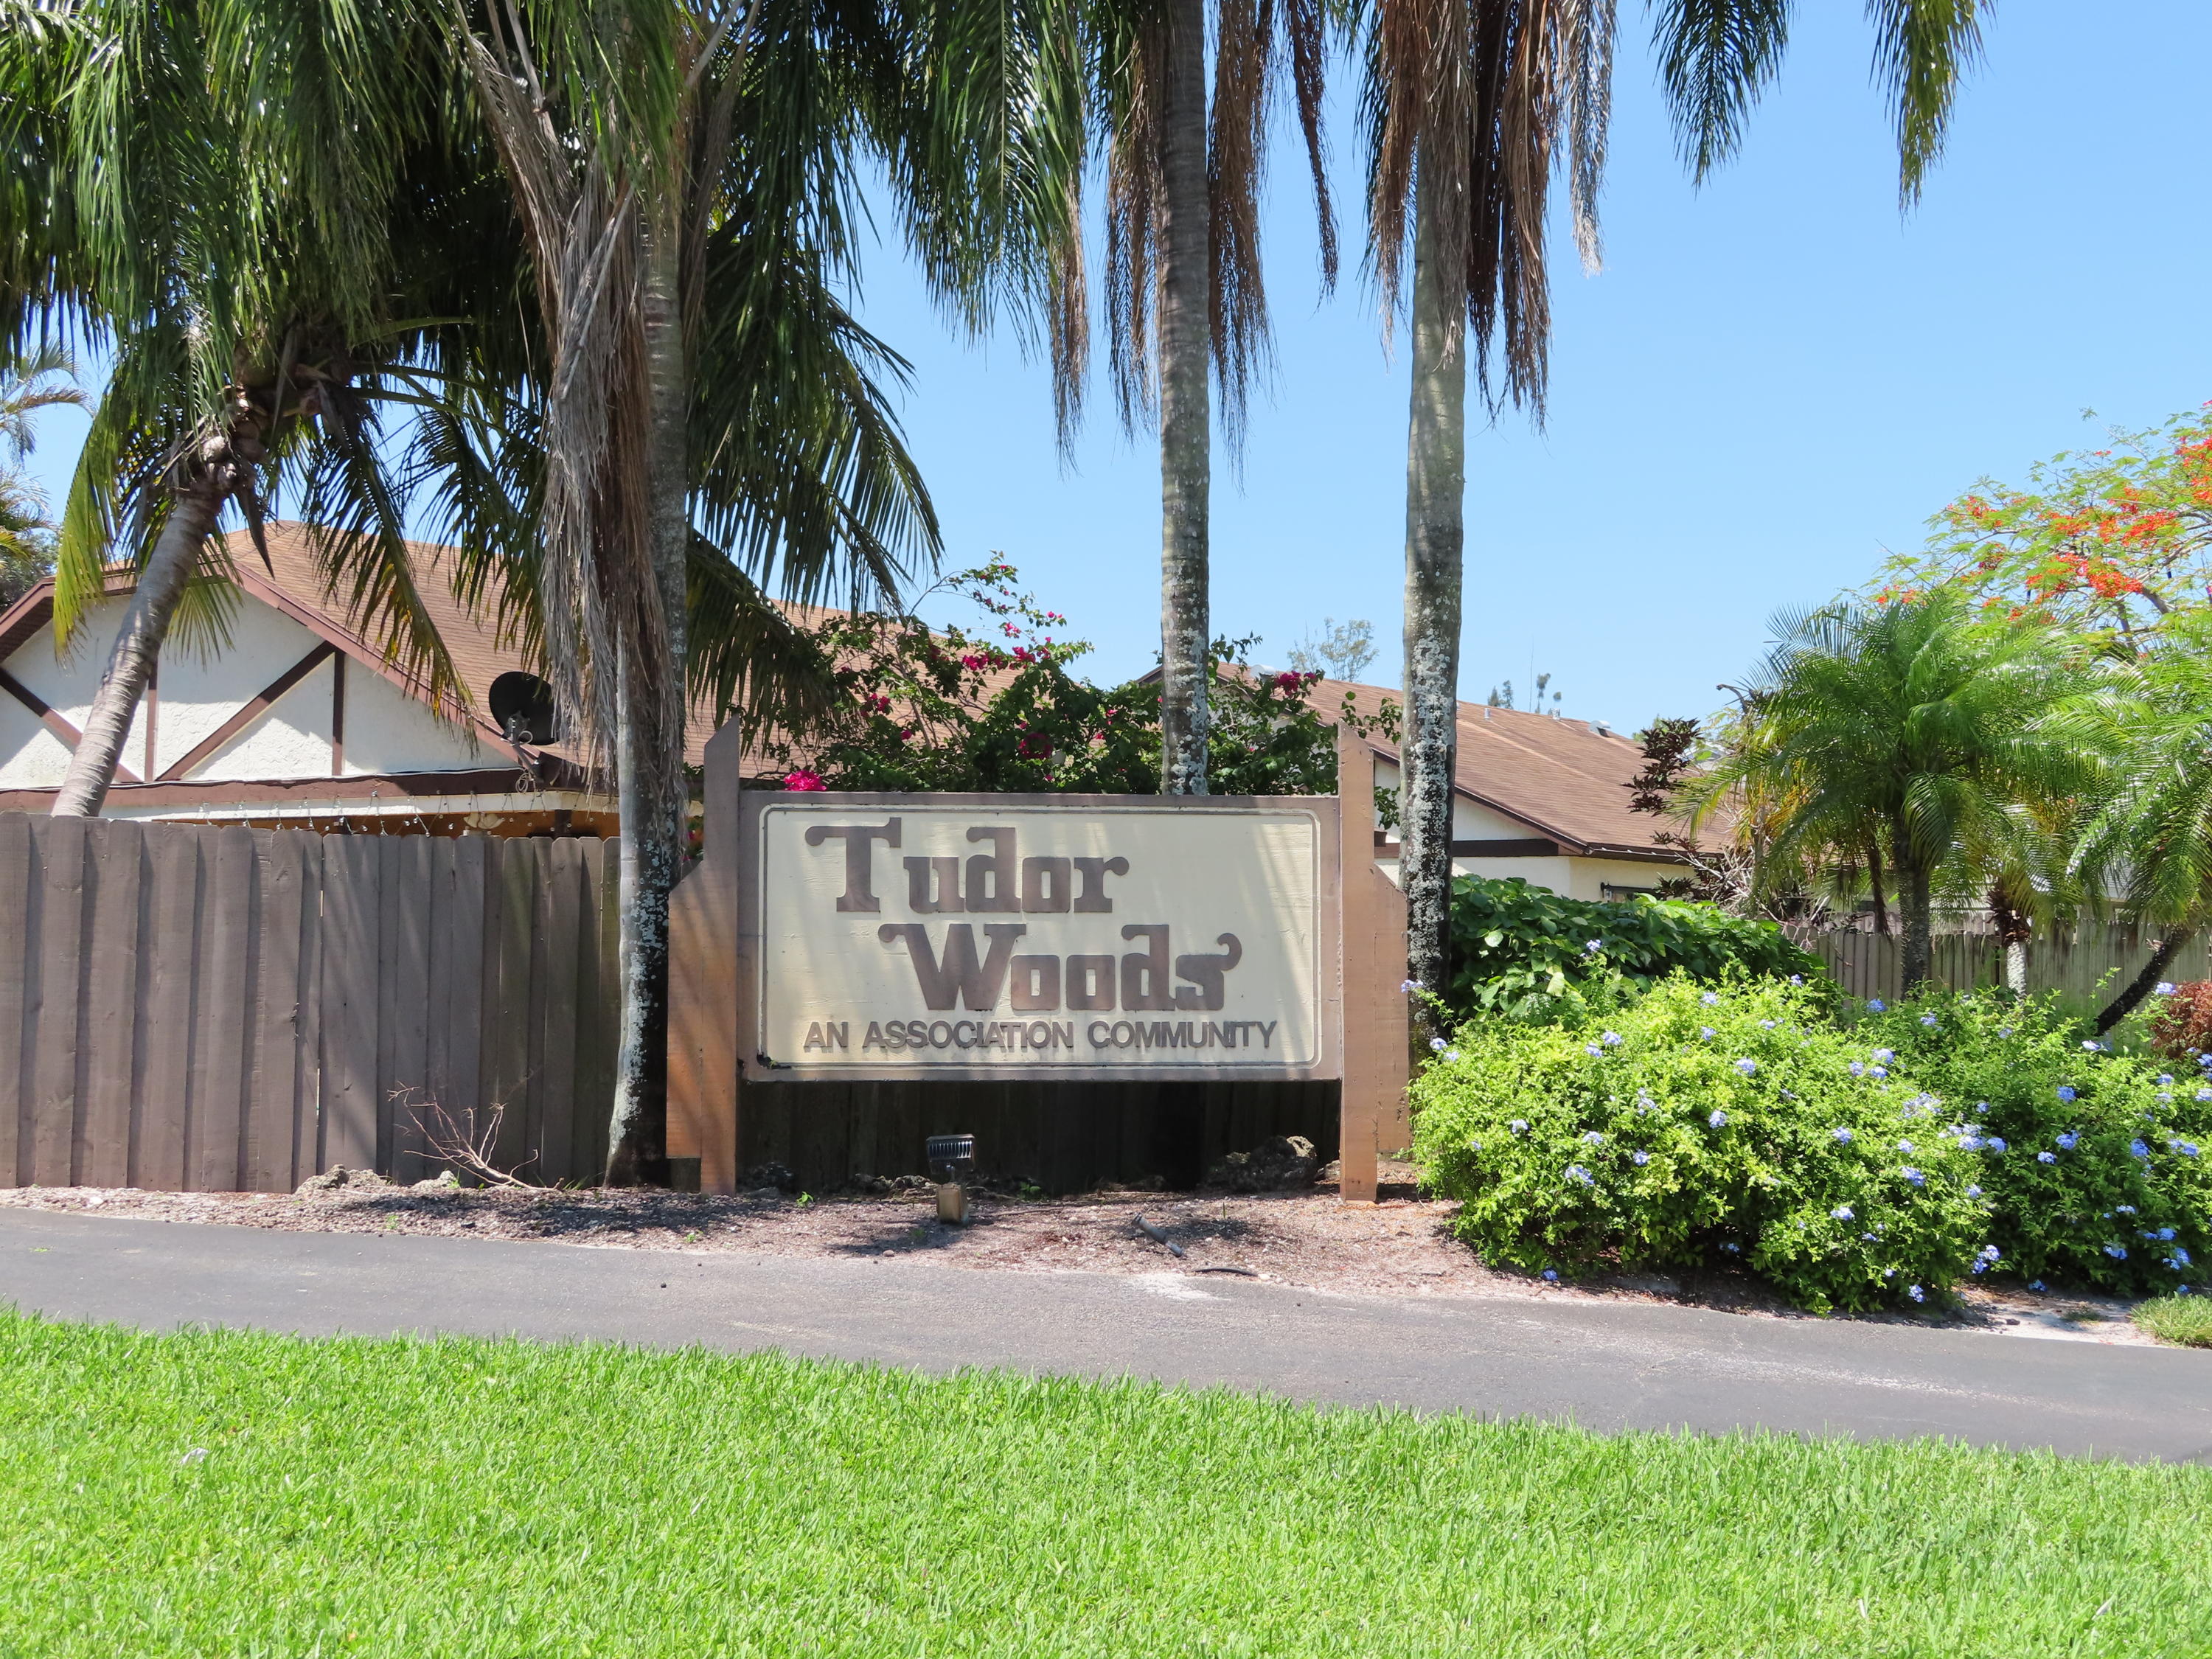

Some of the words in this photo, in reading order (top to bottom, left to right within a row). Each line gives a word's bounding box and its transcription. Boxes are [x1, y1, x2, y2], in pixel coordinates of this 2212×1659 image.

[804, 816, 1130, 914] Tudor
[877, 923, 1242, 1012] Woods
[804, 1021, 848, 1052] AN
[862, 1020, 1074, 1050] ASSOCIATION
[1088, 1020, 1278, 1049] COMMUNITY
